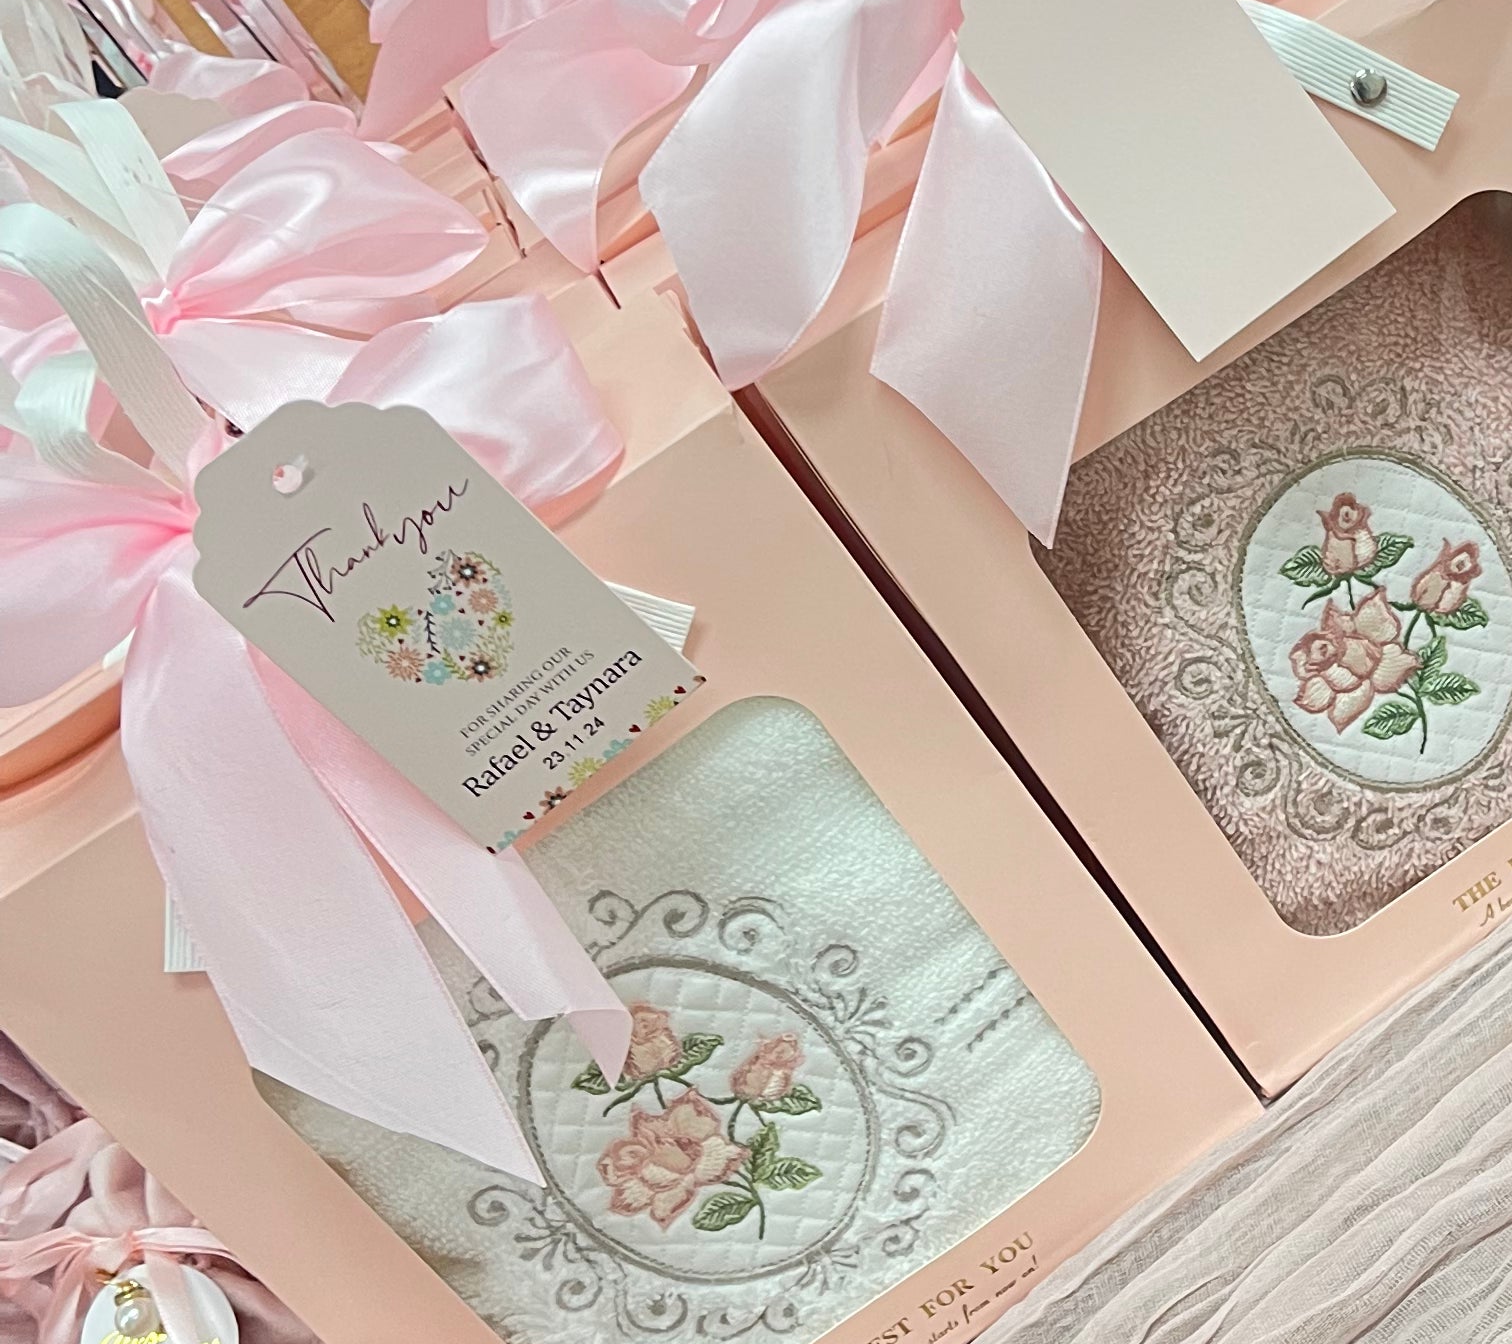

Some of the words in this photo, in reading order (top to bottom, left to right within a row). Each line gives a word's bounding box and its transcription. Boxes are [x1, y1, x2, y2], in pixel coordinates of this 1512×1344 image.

[459, 714, 489, 739] FOR
[486, 669, 544, 718] SHARING
[542, 647, 573, 672] OUR
[462, 734, 537, 798] Rafael
[530, 720, 558, 742] &
[548, 650, 643, 721] Taynara
[465, 714, 517, 757] SPECIAL
[515, 691, 542, 716] DAY
[540, 663, 577, 695] WITH
[579, 649, 595, 667] US
[542, 716, 606, 770] 23.11.24
[1451, 870, 1503, 913] THE
[918, 1278, 976, 1320] FOR
[979, 1231, 1035, 1276] YOU
[963, 1299, 990, 1325] from
